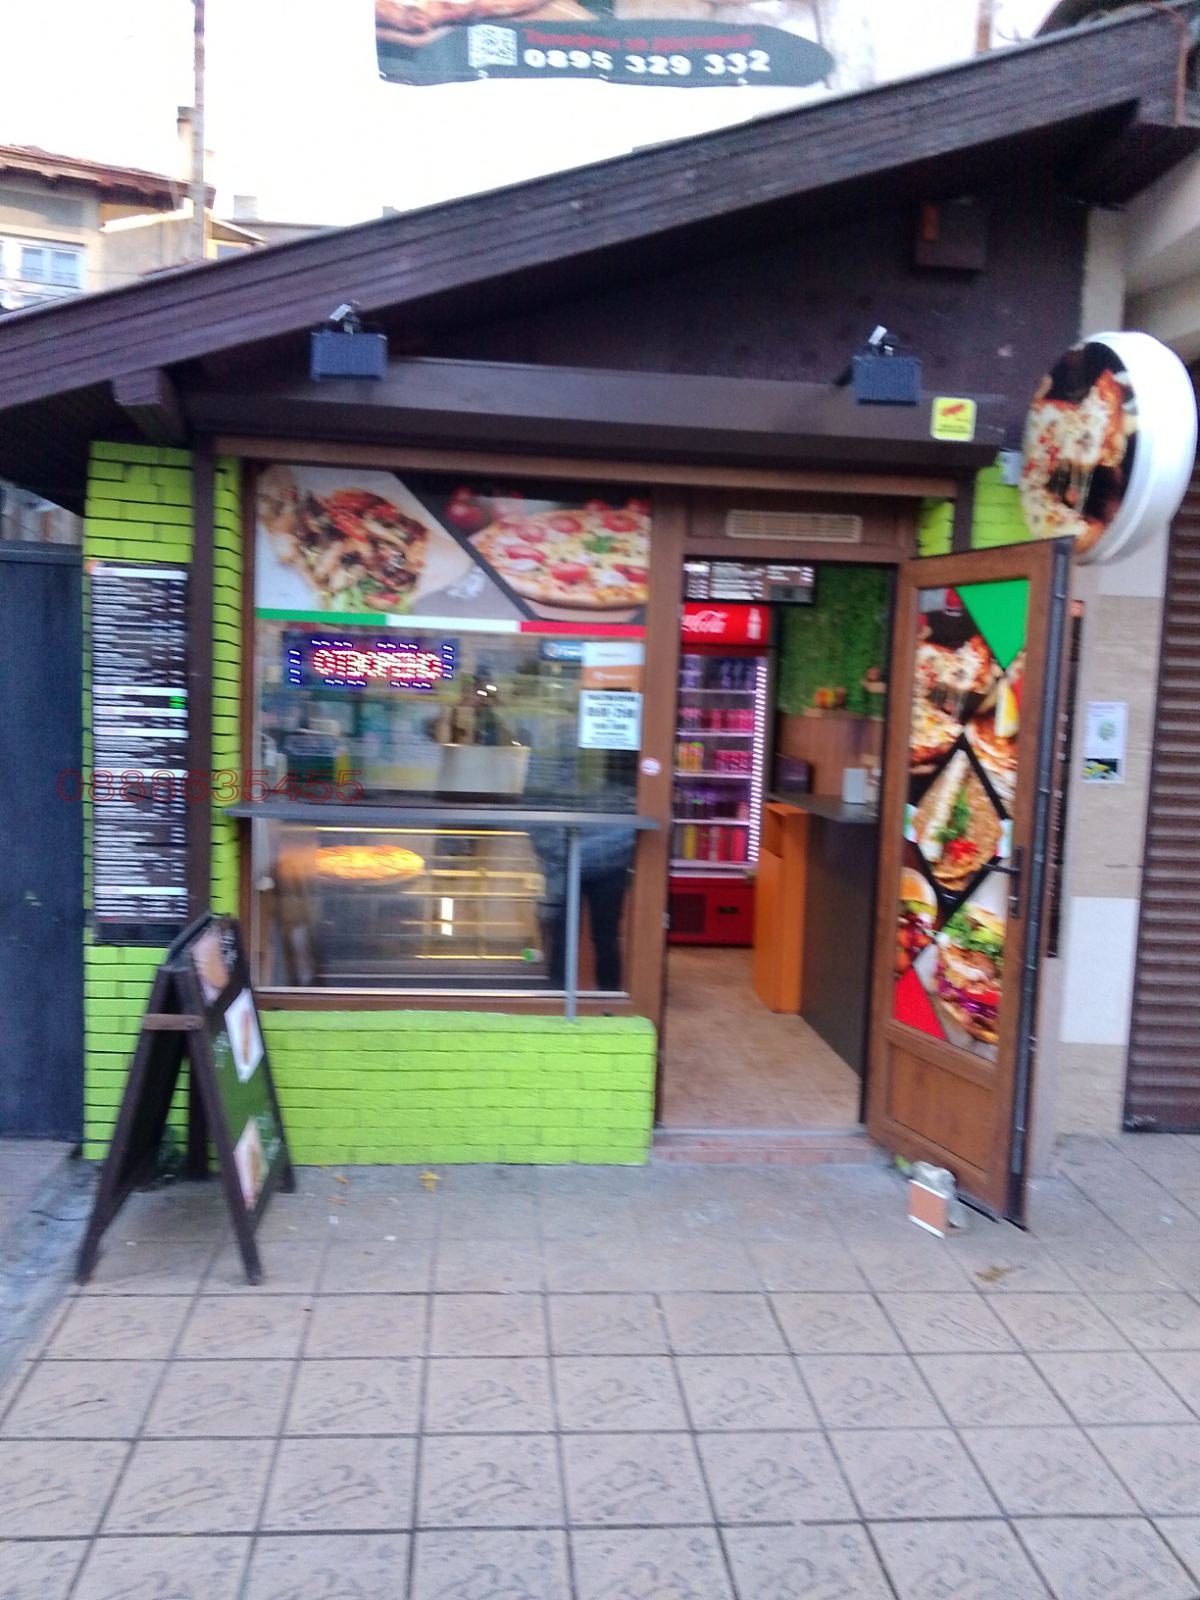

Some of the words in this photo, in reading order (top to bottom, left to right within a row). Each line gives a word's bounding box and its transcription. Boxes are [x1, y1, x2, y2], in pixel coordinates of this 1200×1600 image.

[523, 49, 614, 71] 0895
[624, 54, 692, 76] 329
[703, 49, 771, 75] 332
